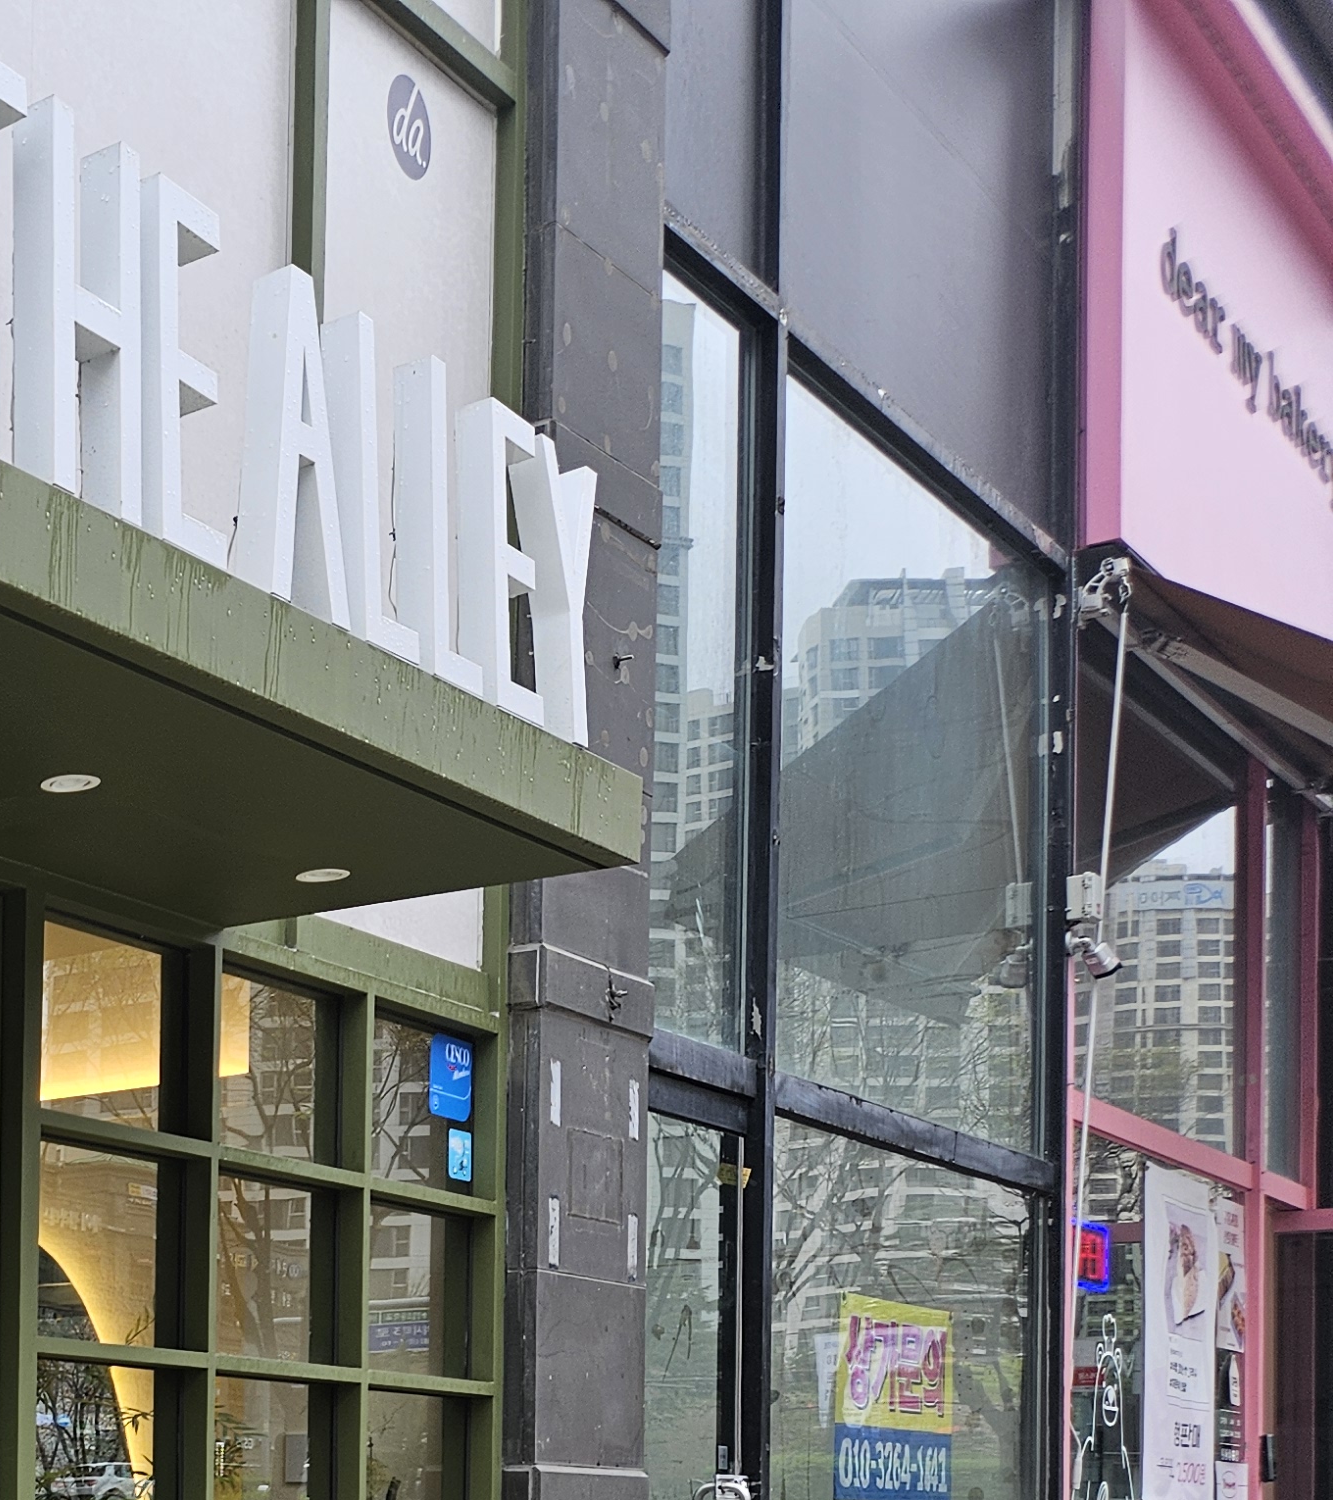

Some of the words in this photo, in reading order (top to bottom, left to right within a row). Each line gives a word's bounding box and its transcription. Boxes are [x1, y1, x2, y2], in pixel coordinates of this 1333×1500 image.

[1160, 226, 1226, 355] dear
[1230, 322, 1263, 414] my
[233, 263, 597, 747] ALLEY
[844, 1314, 948, 1418] 상가문의
